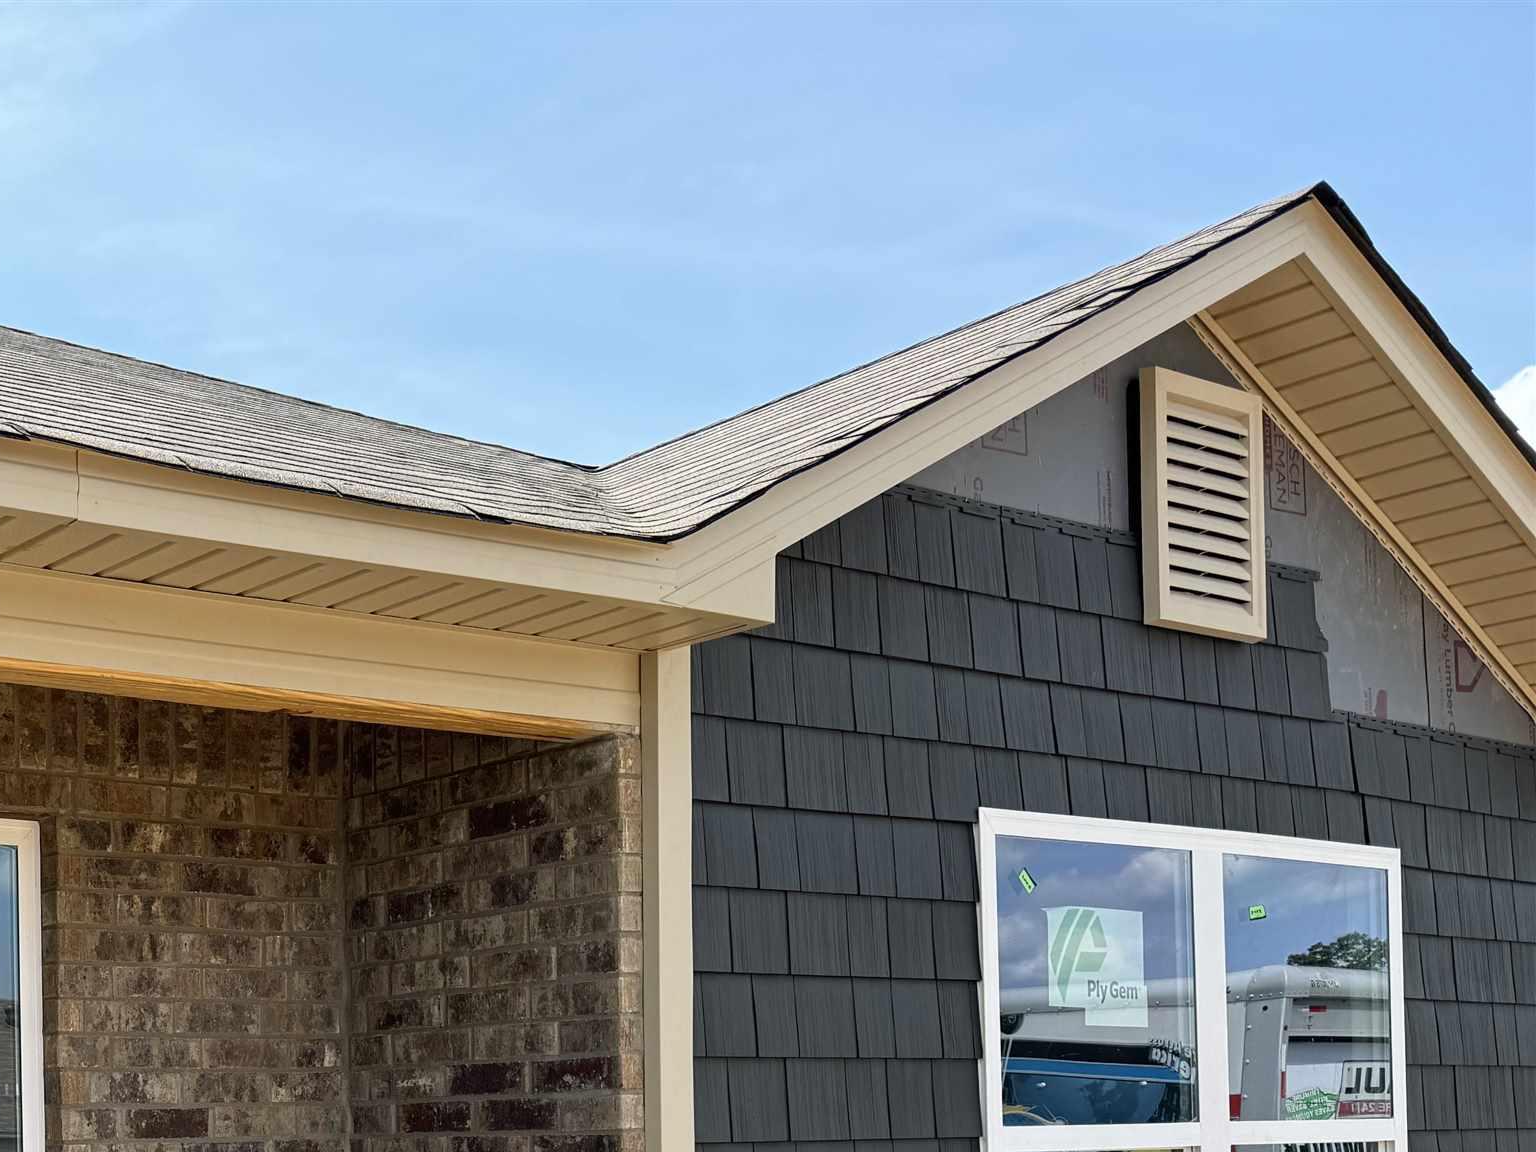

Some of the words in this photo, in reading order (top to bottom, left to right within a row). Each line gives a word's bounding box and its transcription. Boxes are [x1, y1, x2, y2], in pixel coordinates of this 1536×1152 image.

[1444, 649, 1456, 717] Lumber
[1087, 980, 1108, 1004] Ply
[1110, 981, 1138, 999] Gem
